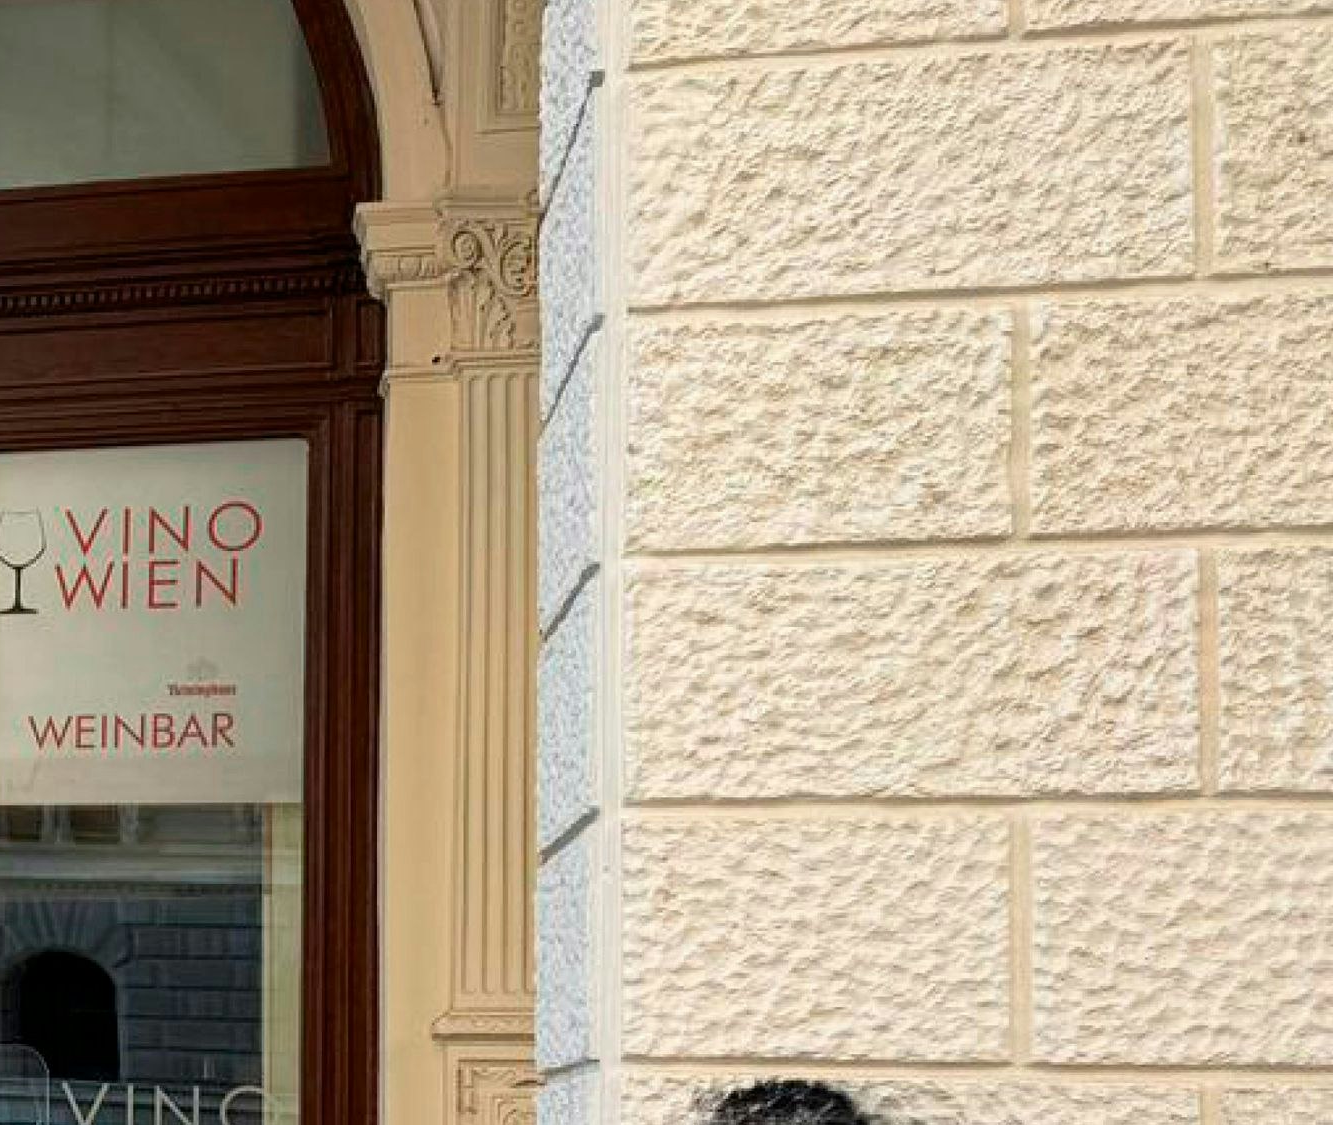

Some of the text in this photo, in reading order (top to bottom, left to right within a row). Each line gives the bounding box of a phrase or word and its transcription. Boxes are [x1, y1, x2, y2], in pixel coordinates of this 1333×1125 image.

[64, 499, 264, 556] VINO
[54, 556, 240, 610] WIEN
[27, 712, 236, 750] WEINBAR
